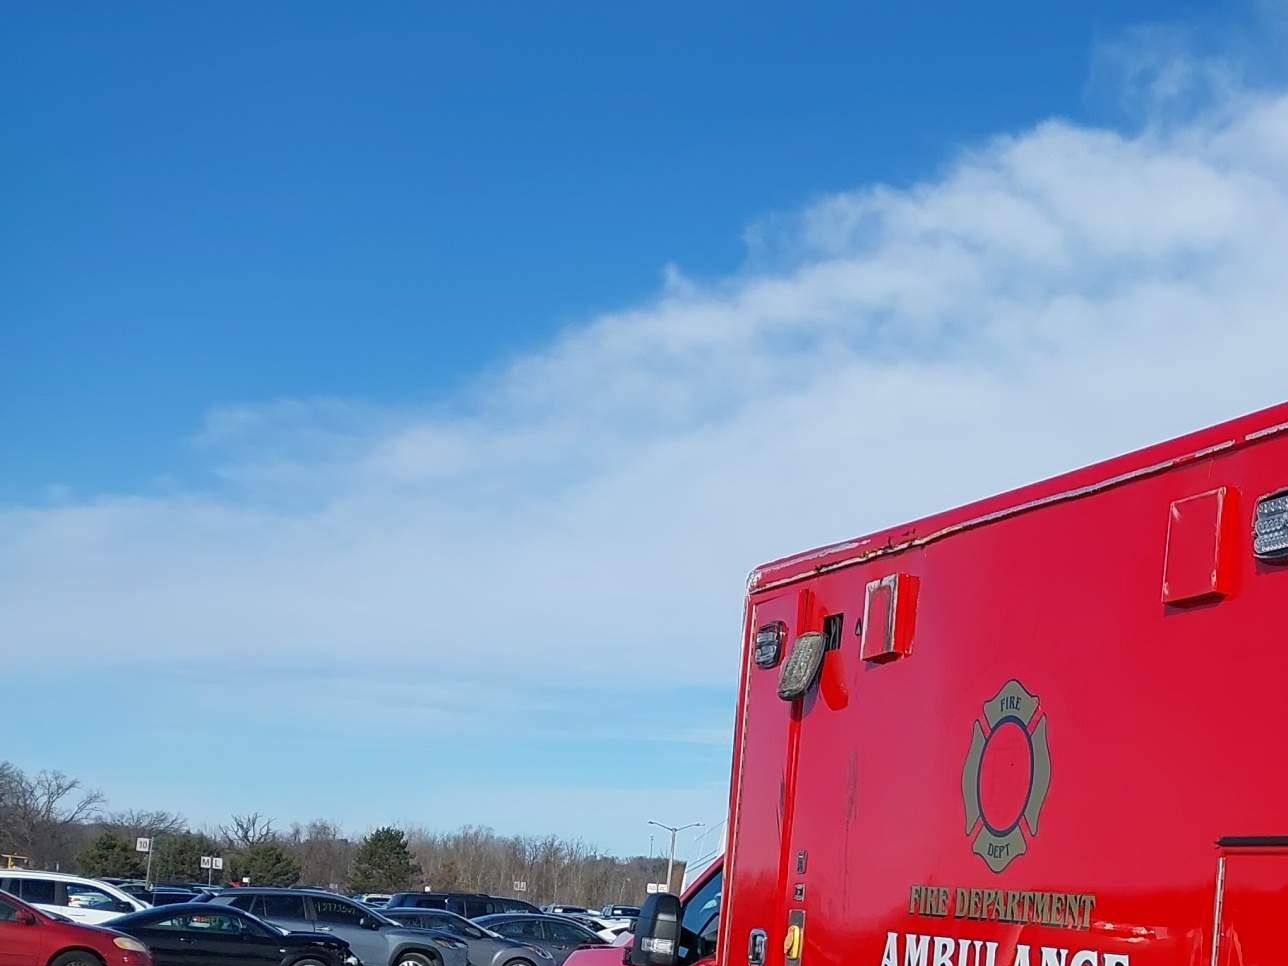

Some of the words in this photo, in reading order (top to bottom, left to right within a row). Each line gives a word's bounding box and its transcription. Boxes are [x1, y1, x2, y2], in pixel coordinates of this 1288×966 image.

[1000, 696, 1022, 713] FIRE
[987, 843, 1011, 859] DEPT
[909, 885, 948, 917] FIRE
[954, 887, 1096, 931] DEPARTMENT
